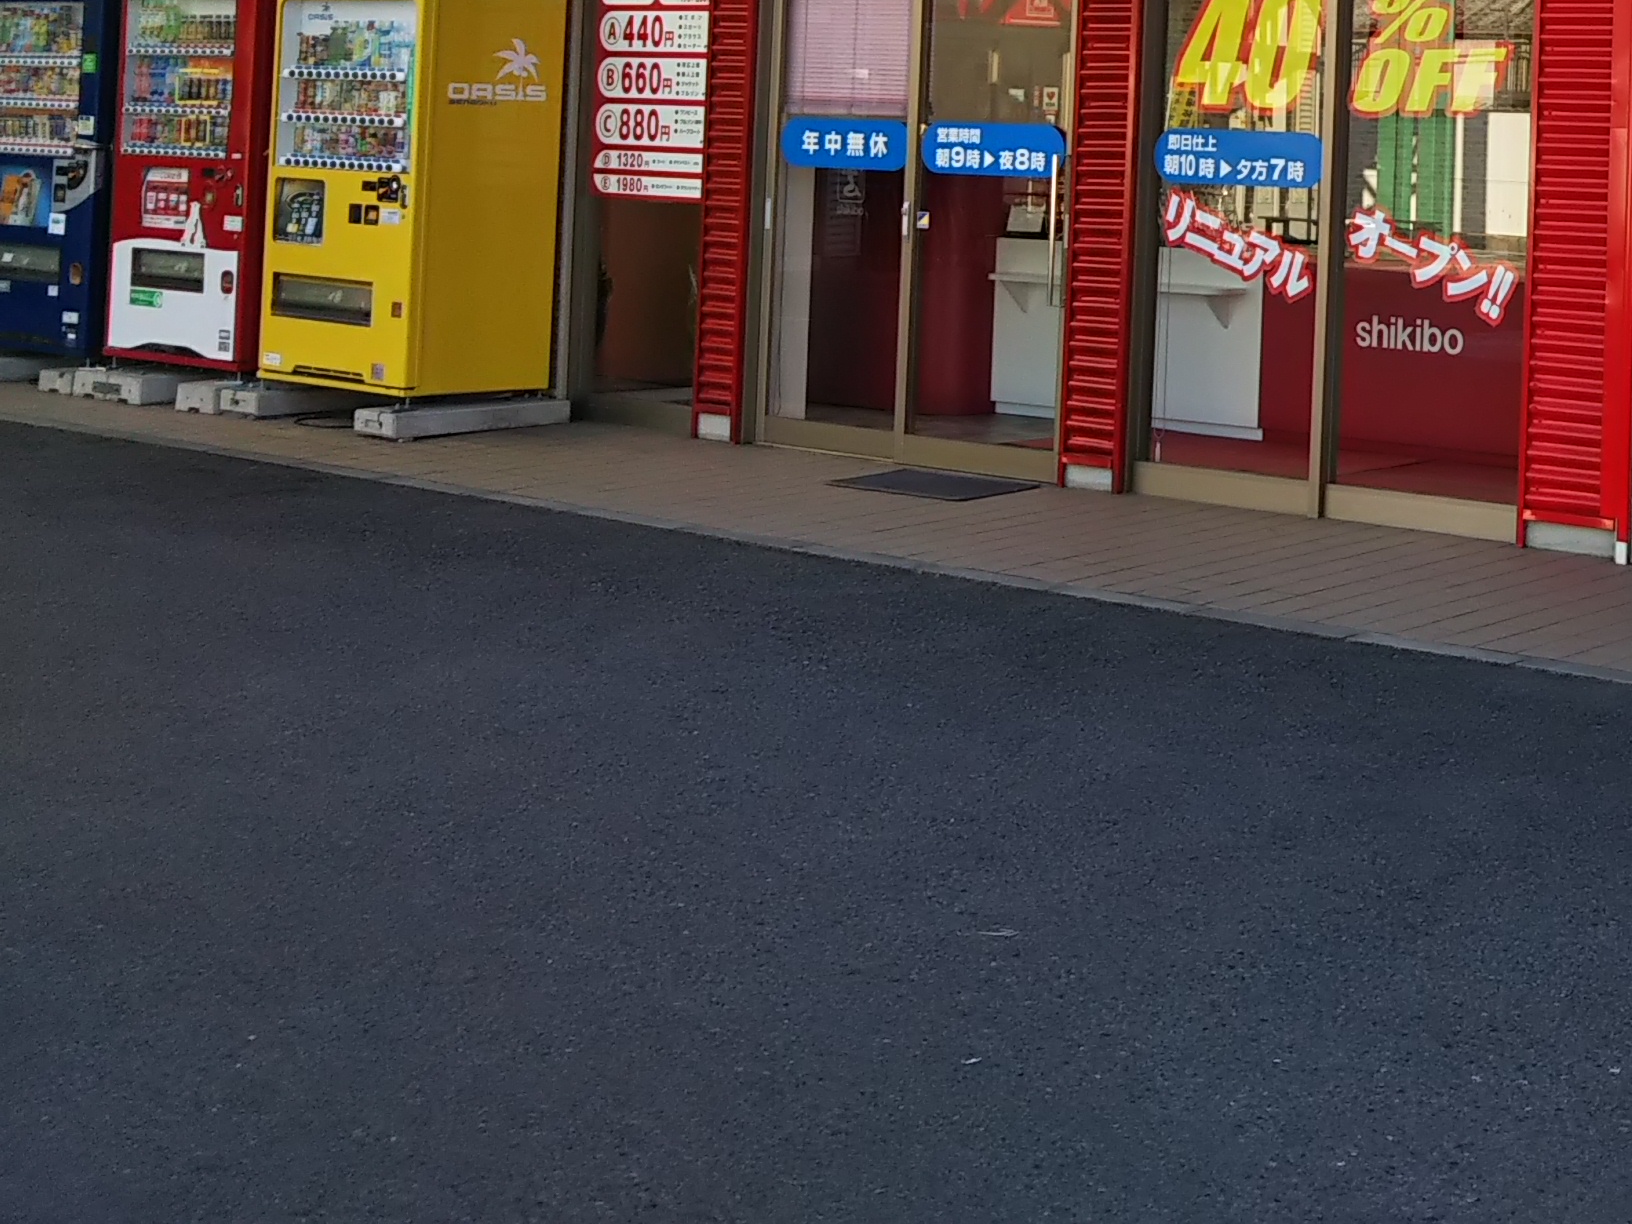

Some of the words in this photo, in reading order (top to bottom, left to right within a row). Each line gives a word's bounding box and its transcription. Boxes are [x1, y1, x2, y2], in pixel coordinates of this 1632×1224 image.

[623, 14, 675, 48] 440円
[447, 82, 547, 102] OASIS
[621, 61, 673, 95] 660円
[1352, 47, 1508, 114] OFF
[619, 108, 671, 142] 880円
[936, 127, 981, 144] 営業時間
[801, 130, 889, 158] 年中無休
[1167, 134, 1218, 152] 即日仕上
[935, 146, 981, 169] 朝9時
[998, 148, 1046, 171] 夜8時
[1163, 154, 1216, 179] 朝10時
[1236, 158, 1305, 182] 夕方7時
[1355, 314, 1464, 356] shikibo
